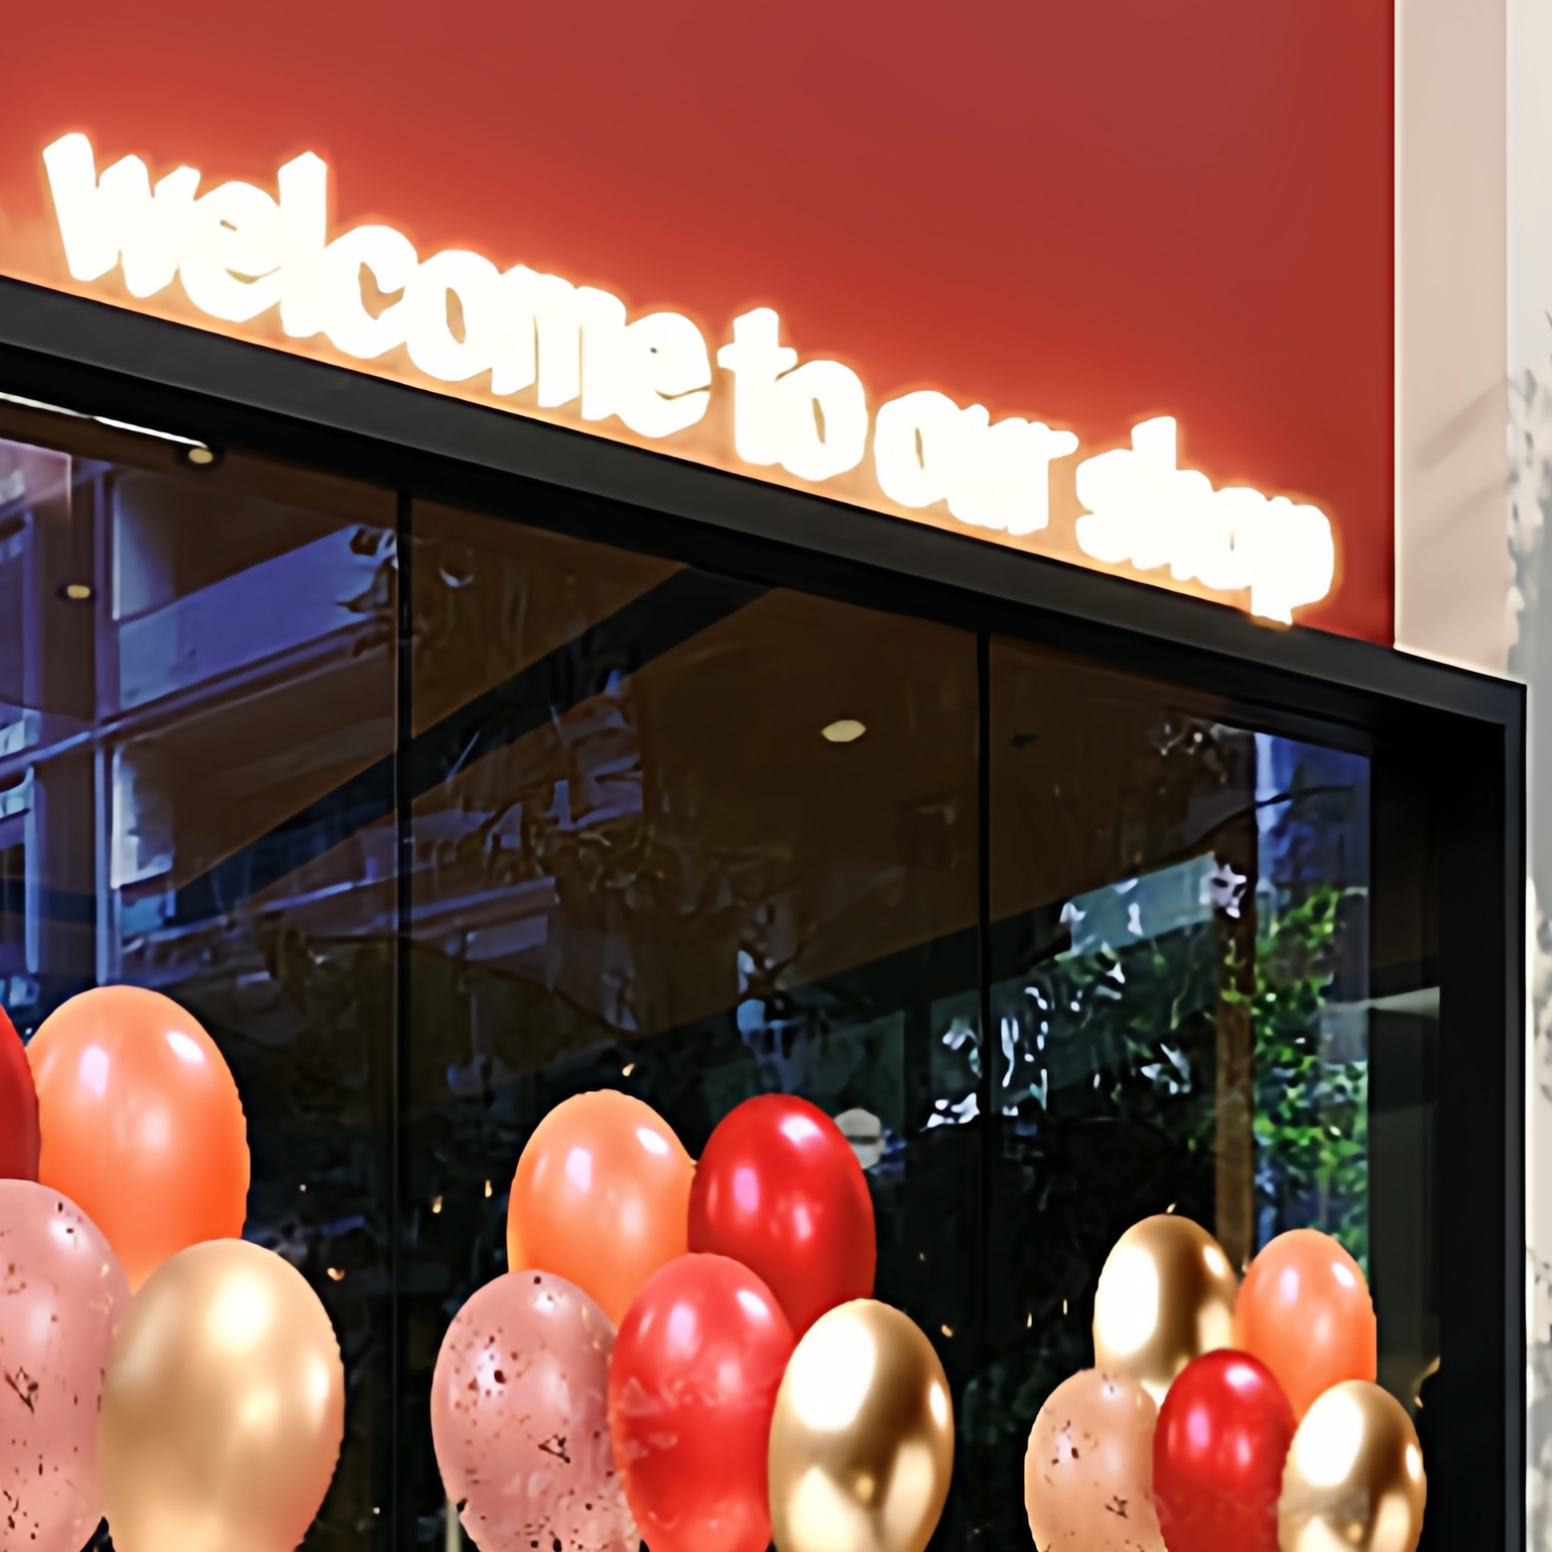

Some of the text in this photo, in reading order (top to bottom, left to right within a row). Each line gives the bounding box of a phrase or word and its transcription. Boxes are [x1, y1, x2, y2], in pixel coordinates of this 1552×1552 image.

[42, 131, 1335, 626] welcome to our shop
